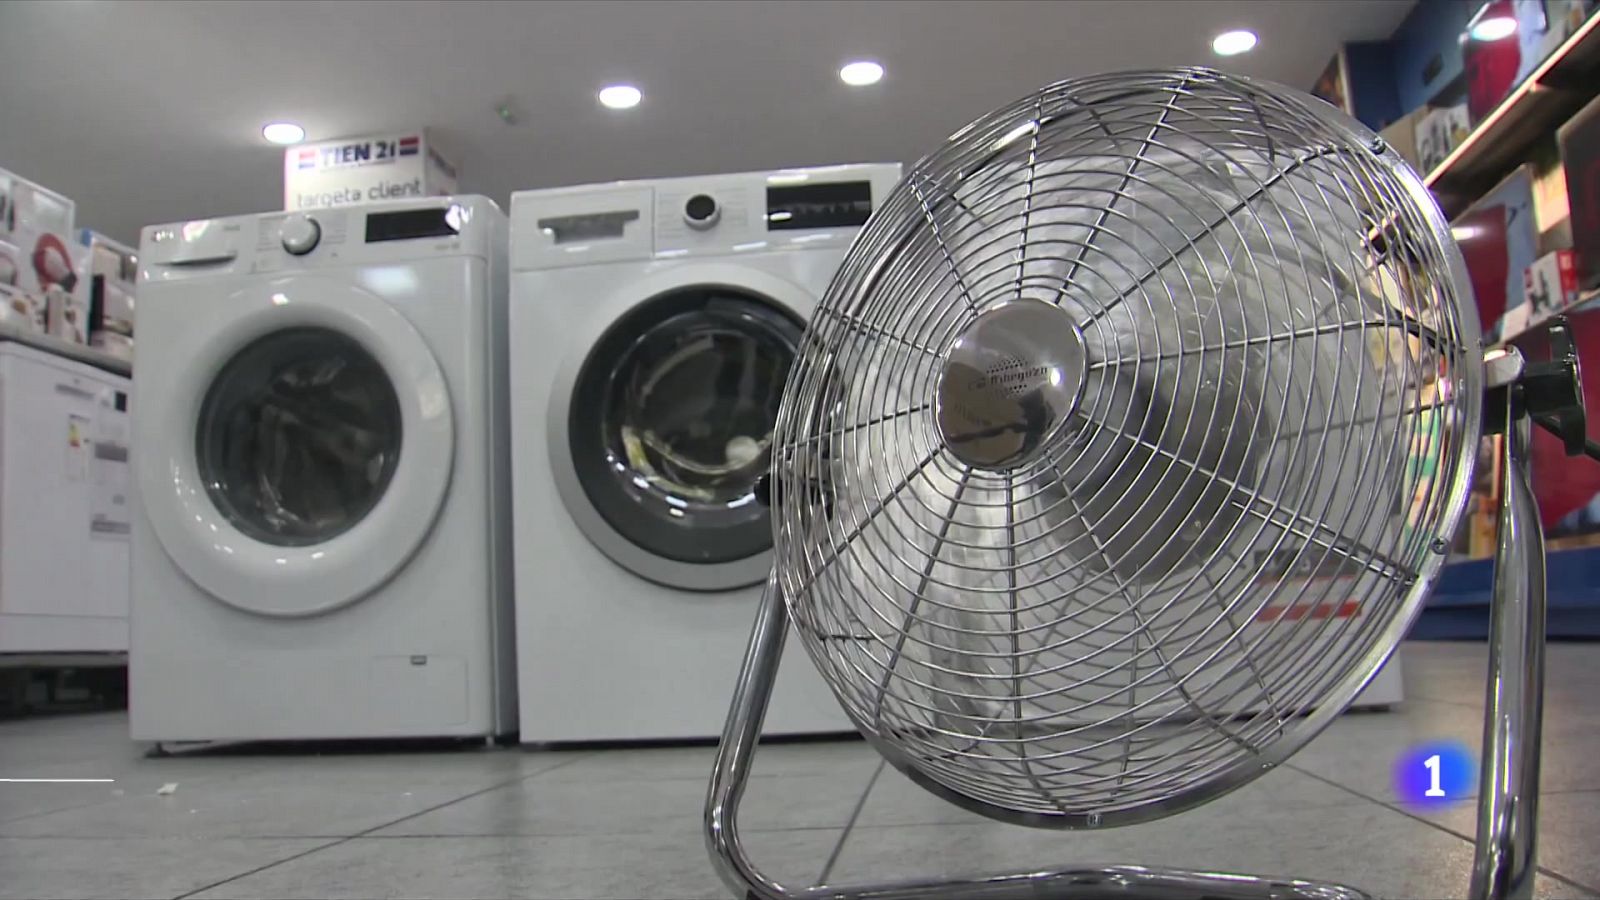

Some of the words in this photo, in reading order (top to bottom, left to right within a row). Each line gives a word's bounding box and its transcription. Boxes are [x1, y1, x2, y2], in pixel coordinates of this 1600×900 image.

[321, 143, 370, 167] TIEN
[375, 140, 396, 159] 21
[296, 187, 361, 208] targeta
[368, 178, 420, 200] client
